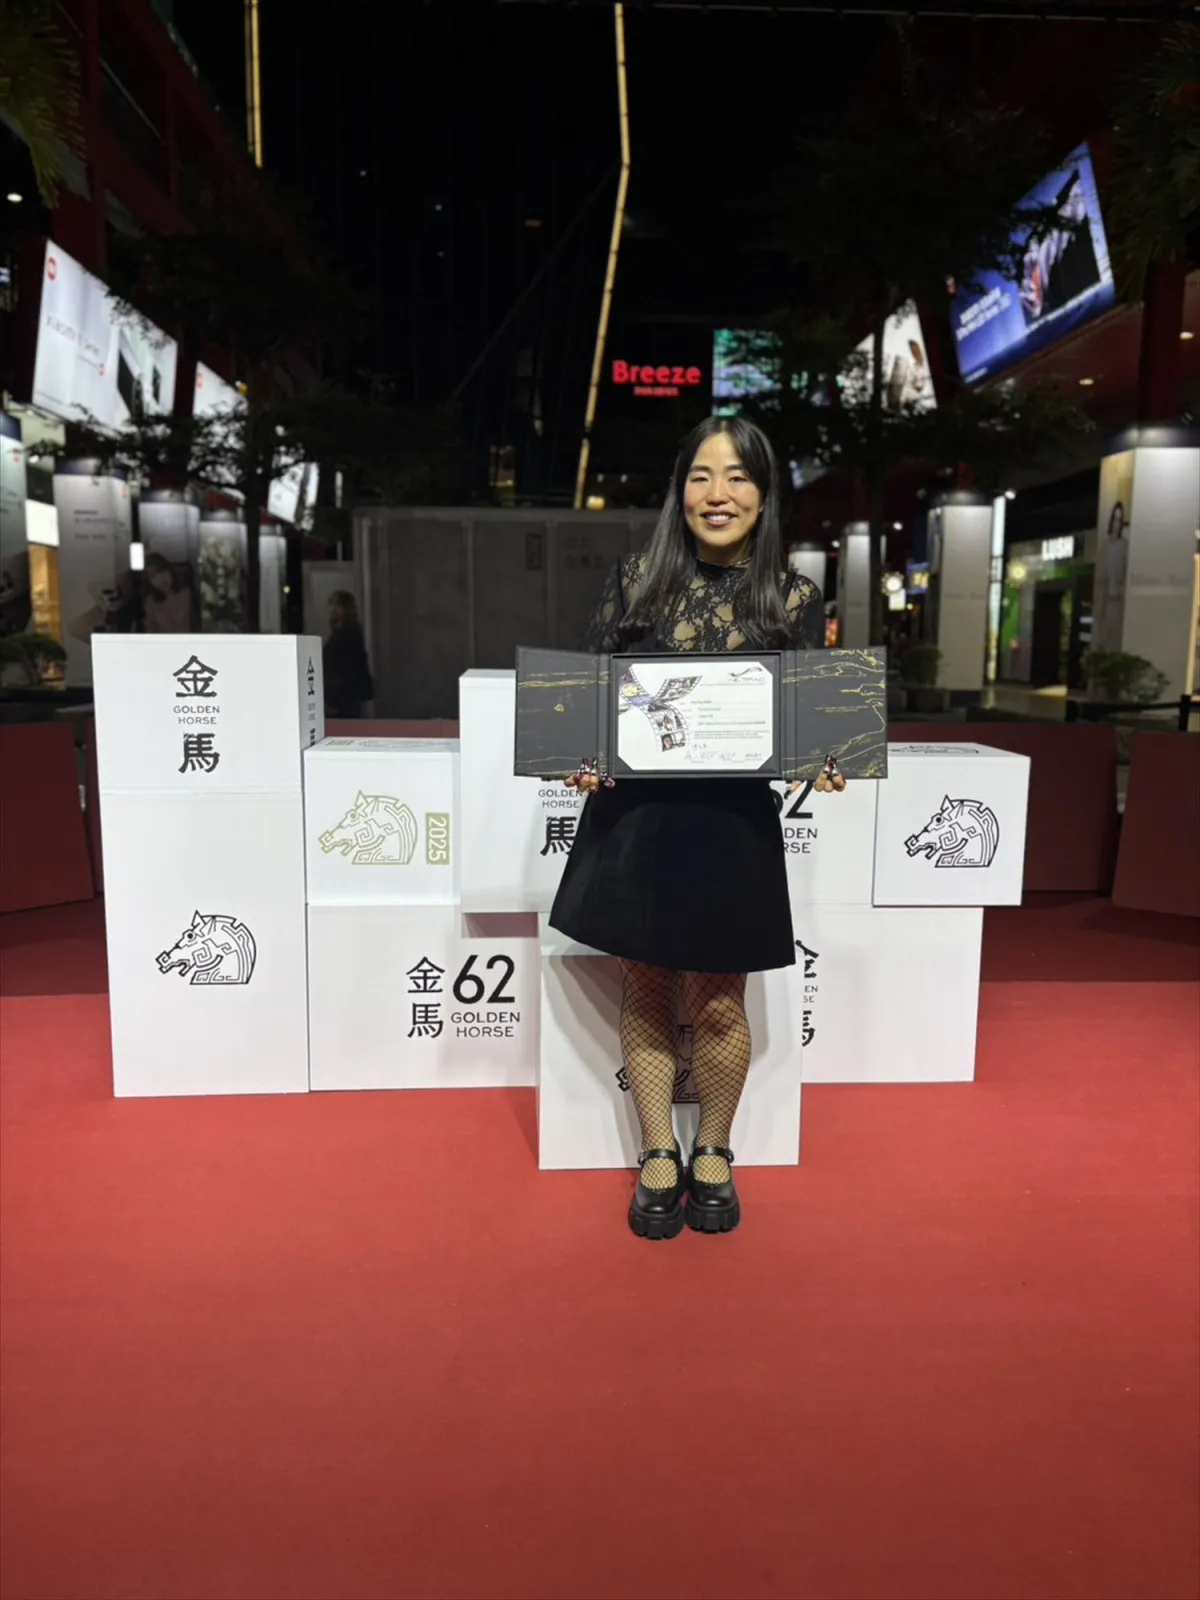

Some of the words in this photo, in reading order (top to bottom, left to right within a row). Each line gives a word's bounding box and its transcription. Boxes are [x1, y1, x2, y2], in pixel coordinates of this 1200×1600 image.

[613, 360, 702, 385] Breeze
[173, 654, 219, 698] 金
[173, 705, 221, 714] GOLDEN
[178, 716, 217, 725] HORSE
[178, 732, 221, 774] 馬
[542, 800, 580, 808] HORSE
[428, 816, 447, 862] 2025
[540, 816, 578, 857] 馬
[784, 827, 818, 839] DEN
[452, 954, 515, 1004] 62
[405, 955, 446, 1039] 金馬
[451, 1011, 520, 1024] GOLDEN
[456, 1026, 514, 1038] HORSE
